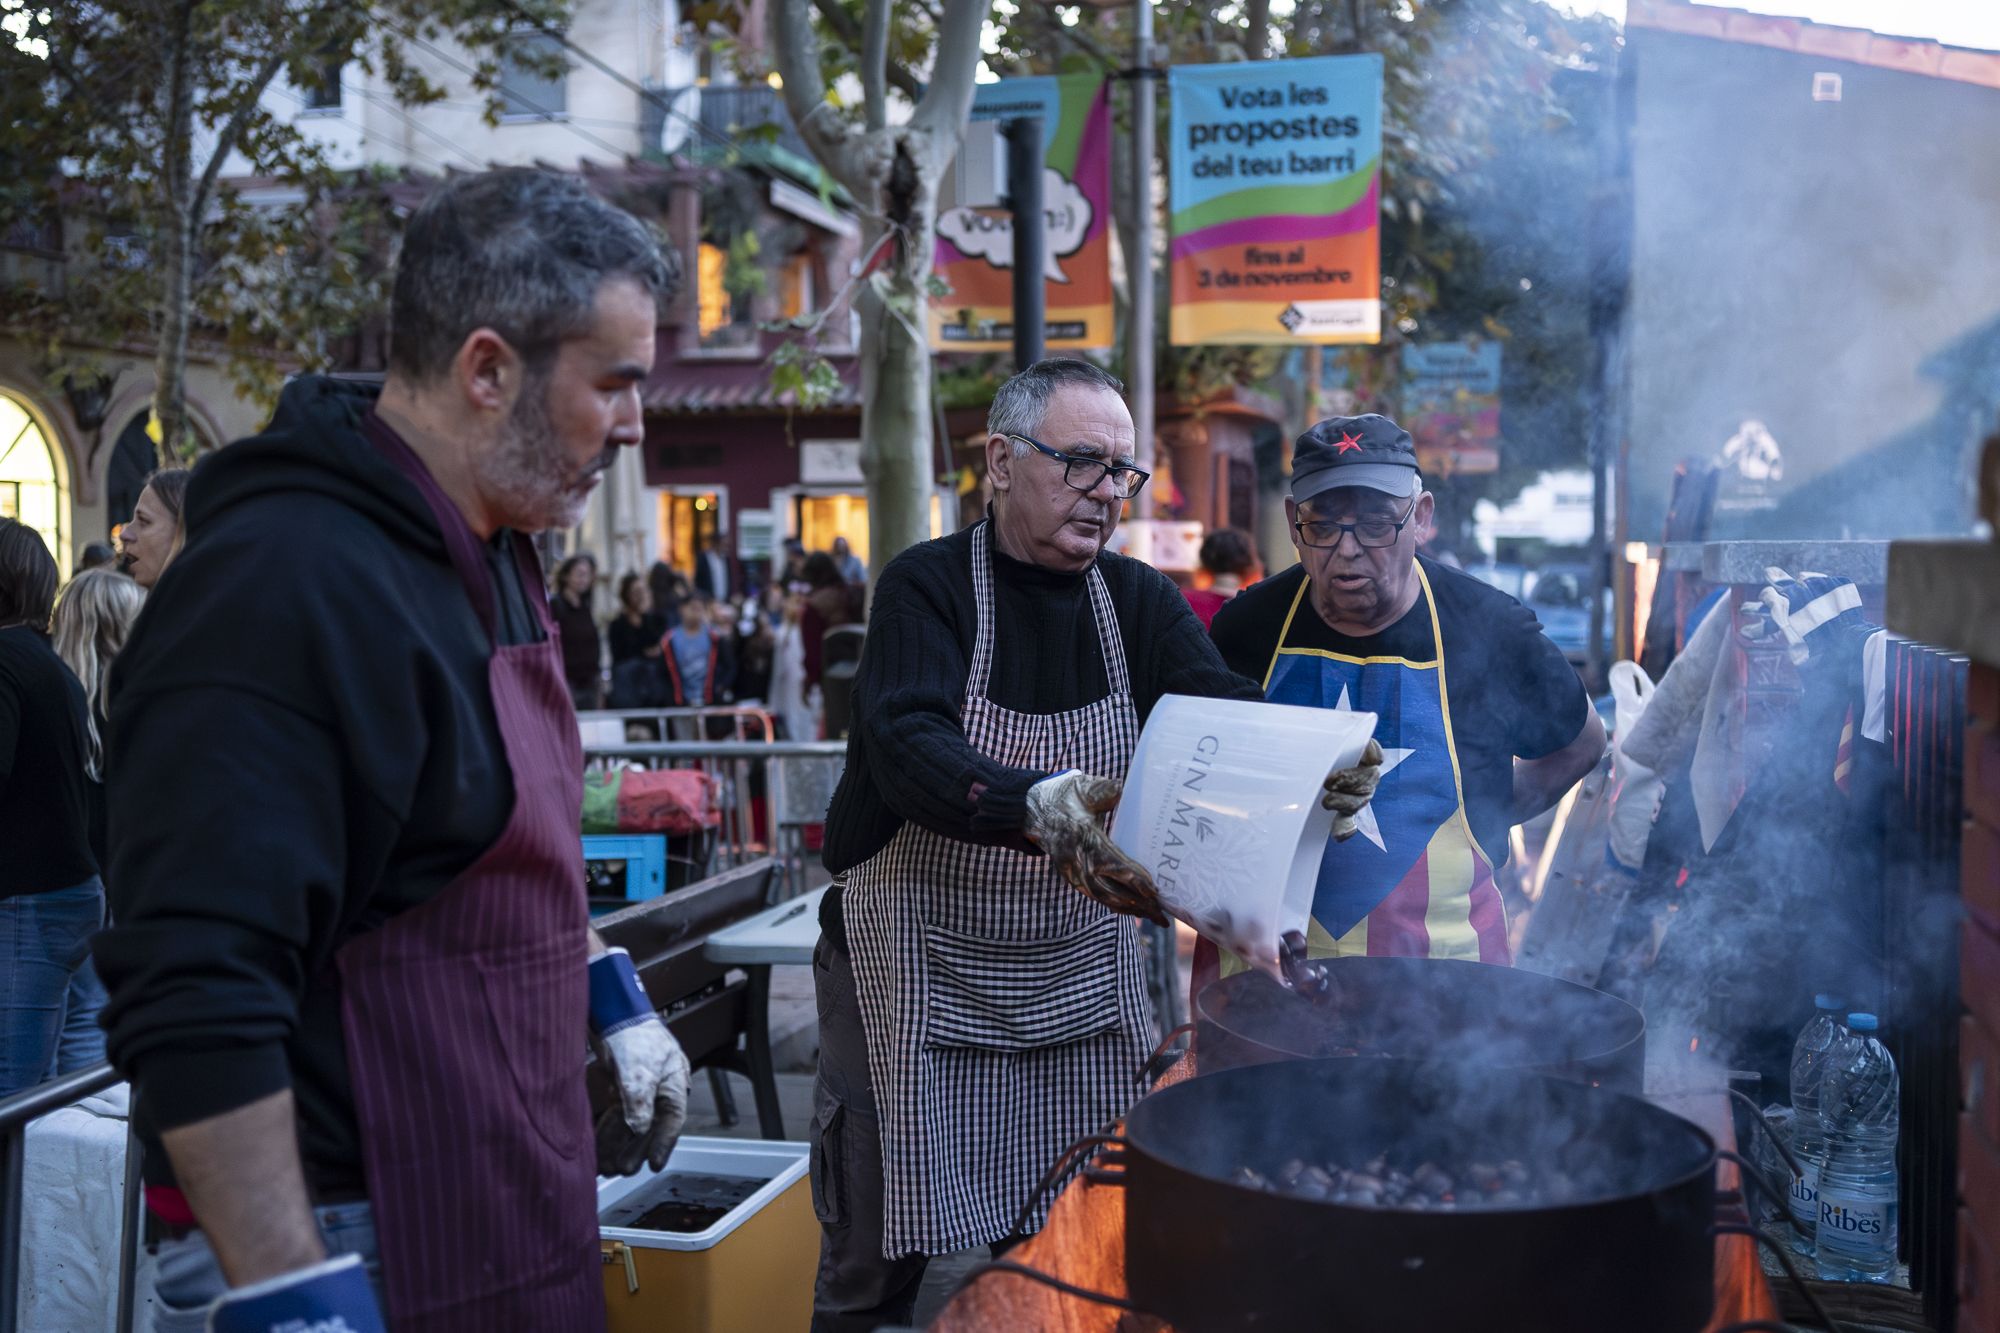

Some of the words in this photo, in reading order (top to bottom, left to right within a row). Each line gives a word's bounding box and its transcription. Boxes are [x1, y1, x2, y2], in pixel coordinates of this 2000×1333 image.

[1219, 86, 1283, 109] Vota
[1288, 81, 1329, 106] les
[1188, 114, 1359, 151] propostes
[1192, 154, 1233, 178] del
[1239, 156, 1282, 176] teu
[1288, 148, 1355, 174] barri
[1246, 246, 1281, 265] fins
[1287, 247, 1304, 264] al
[1216, 268, 1239, 286] de
[1245, 267, 1352, 286] novembre
[1183, 735, 1219, 792] GIN
[1156, 799, 1195, 892] MARE
[1820, 1200, 1881, 1234] Ribes
